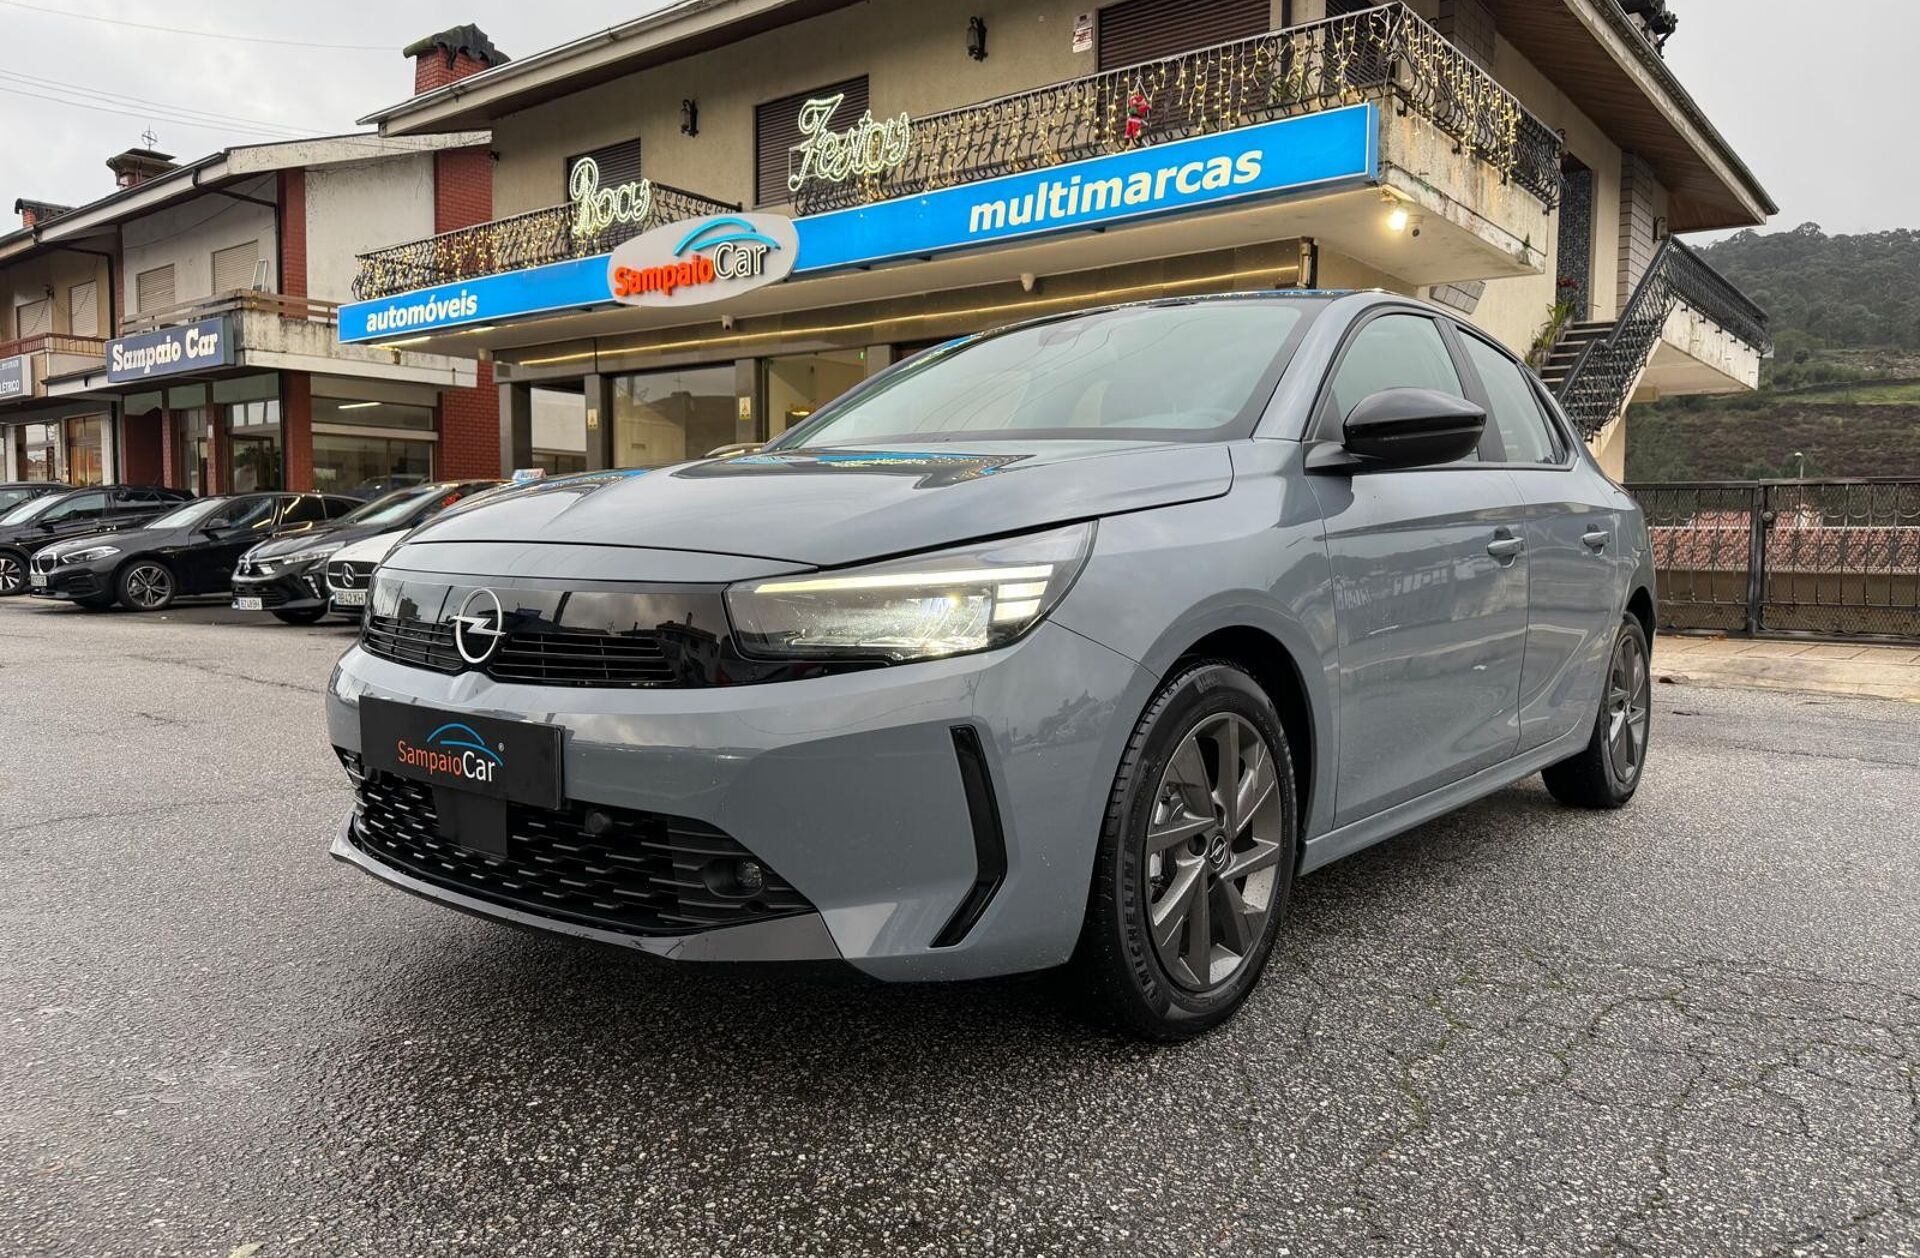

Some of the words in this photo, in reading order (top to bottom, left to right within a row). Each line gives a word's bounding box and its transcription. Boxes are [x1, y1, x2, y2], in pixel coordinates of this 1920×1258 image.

[969, 150, 1263, 233] multimarcas
[366, 289, 478, 332] automóveis
[112, 334, 181, 374] Sampaio
[185, 328, 218, 359] Car
[1122, 861, 1152, 987] MICHELIN
